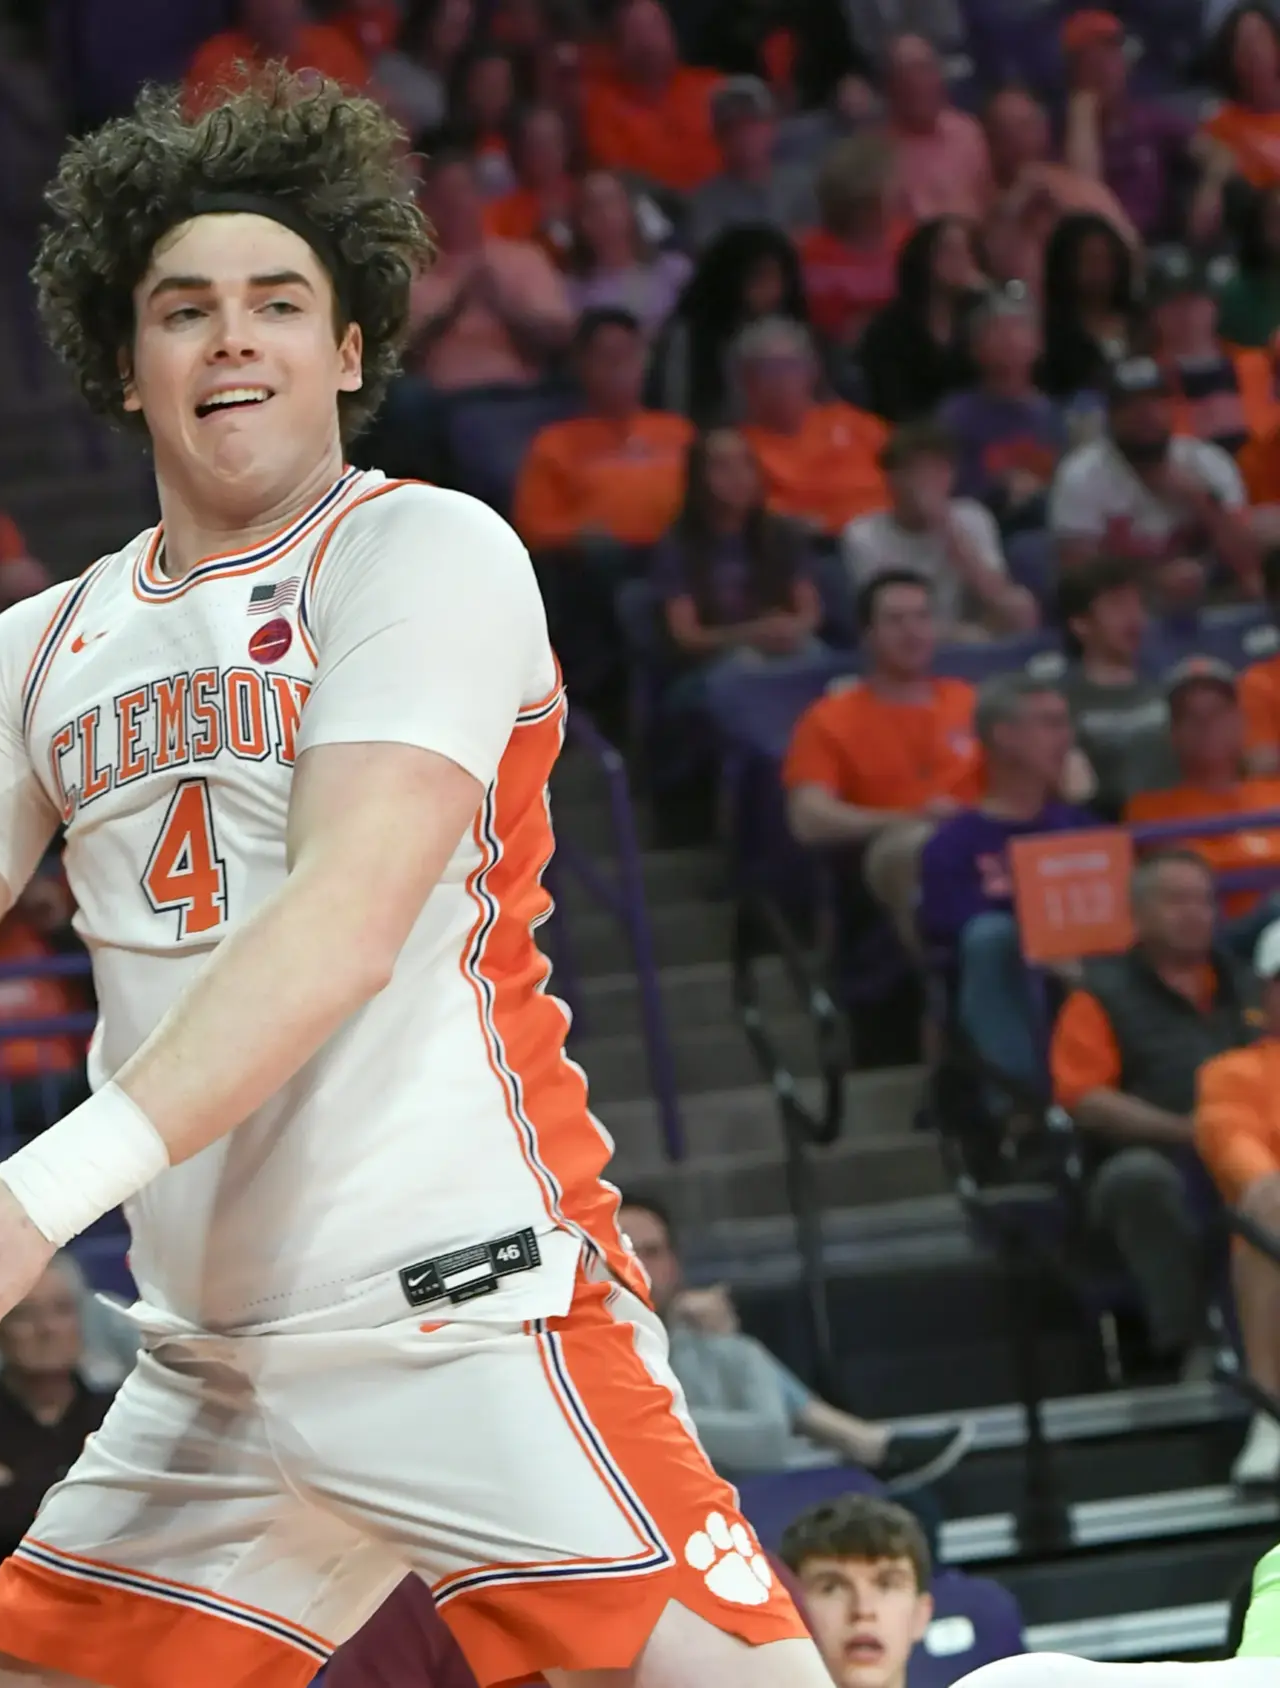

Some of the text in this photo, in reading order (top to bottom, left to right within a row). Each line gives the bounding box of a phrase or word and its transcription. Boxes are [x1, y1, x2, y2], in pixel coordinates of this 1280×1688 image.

[48, 666, 312, 825] CLEMSON
[140, 776, 228, 942] 4
[496, 1244, 520, 1262] 46
